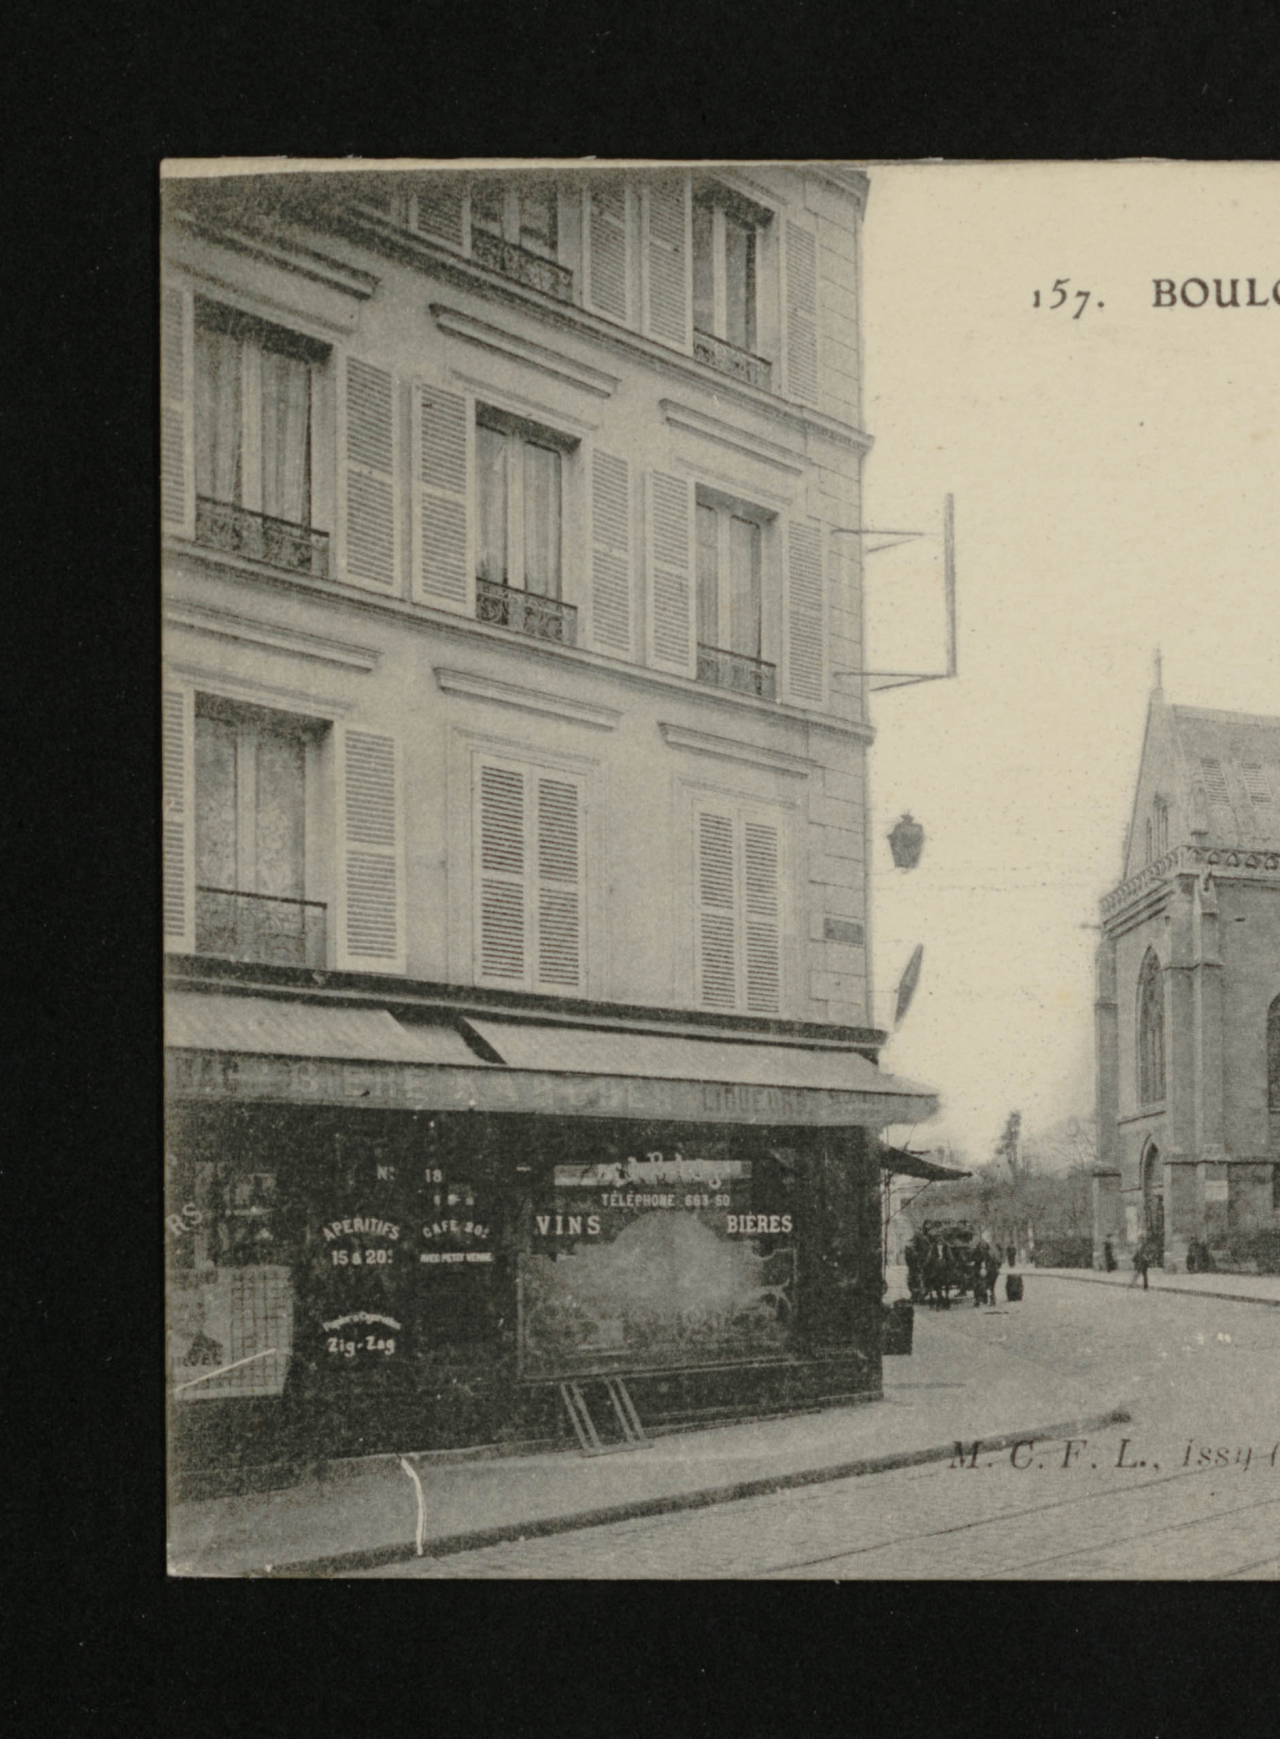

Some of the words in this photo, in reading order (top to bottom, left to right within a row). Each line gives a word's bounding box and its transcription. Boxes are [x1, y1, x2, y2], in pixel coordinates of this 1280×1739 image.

[424, 1168, 443, 1184] 18
[601, 1190, 675, 1207] TÉLÉPHONE
[536, 1215, 601, 1235] VINS
[331, 1250, 349, 1266] 15
[326, 1335, 396, 1357] Zig-Zag
